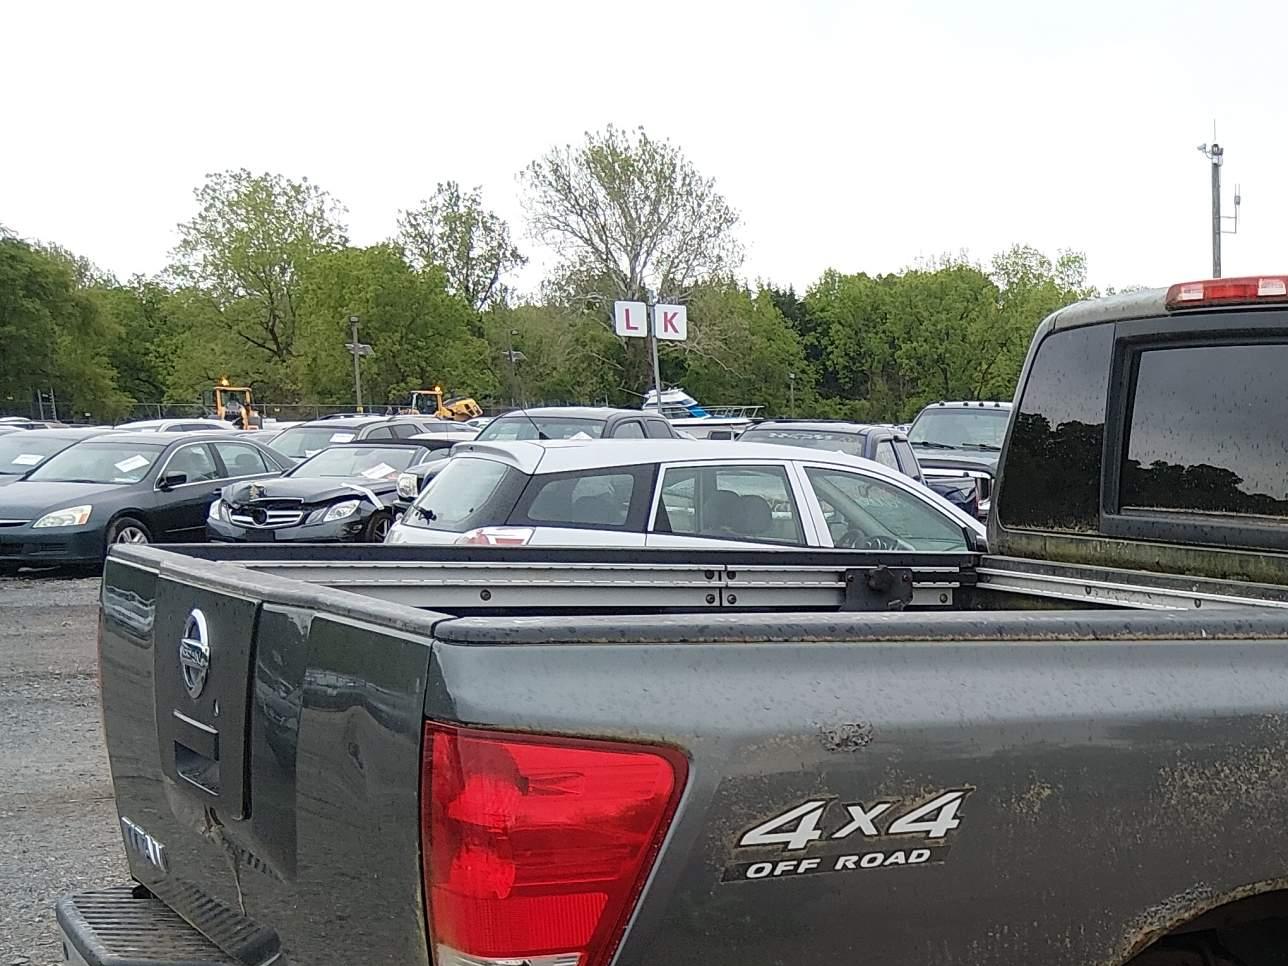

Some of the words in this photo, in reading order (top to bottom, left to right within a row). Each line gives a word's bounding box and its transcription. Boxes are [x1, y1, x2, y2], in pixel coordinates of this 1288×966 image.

[624, 308, 639, 331] L
[663, 311, 680, 334] K
[745, 858, 822, 879] OFF
[833, 849, 931, 871] ROAD
